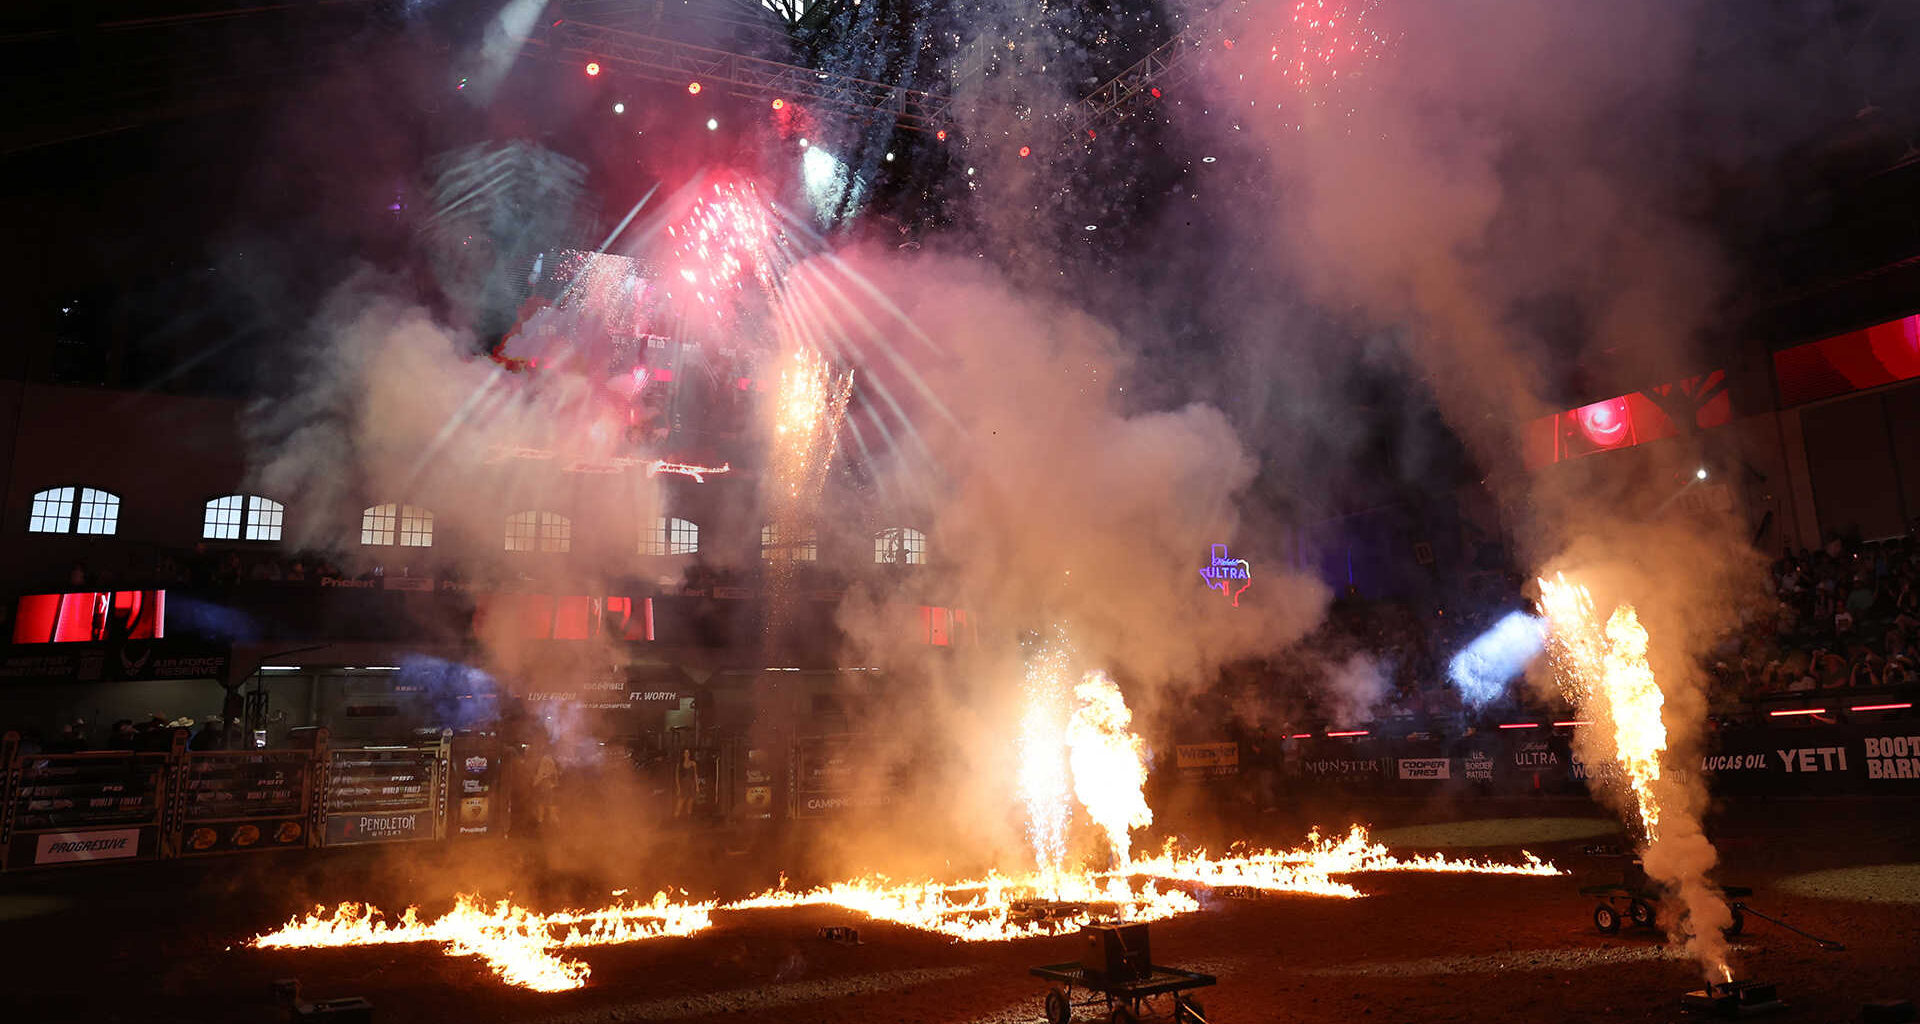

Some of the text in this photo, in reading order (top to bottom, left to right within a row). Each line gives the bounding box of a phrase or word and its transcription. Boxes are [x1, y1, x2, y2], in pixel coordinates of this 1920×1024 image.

[1206, 566, 1248, 579] ULTRA
[527, 692, 549, 701] LIVE
[629, 692, 676, 700] FT. WORTH
[1402, 761, 1445, 769] COOPER
[1515, 752, 1558, 766] ULTRA
[1701, 754, 1766, 771] LUCAS OIL
[1776, 747, 1848, 773] YETI
[1464, 760, 1494, 771] BORDER
[1408, 769, 1438, 777] TIRES
[1465, 770, 1493, 780] PATROL
[360, 815, 416, 835] PENDLETON
[48, 837, 128, 854] PROGRESSIVE
